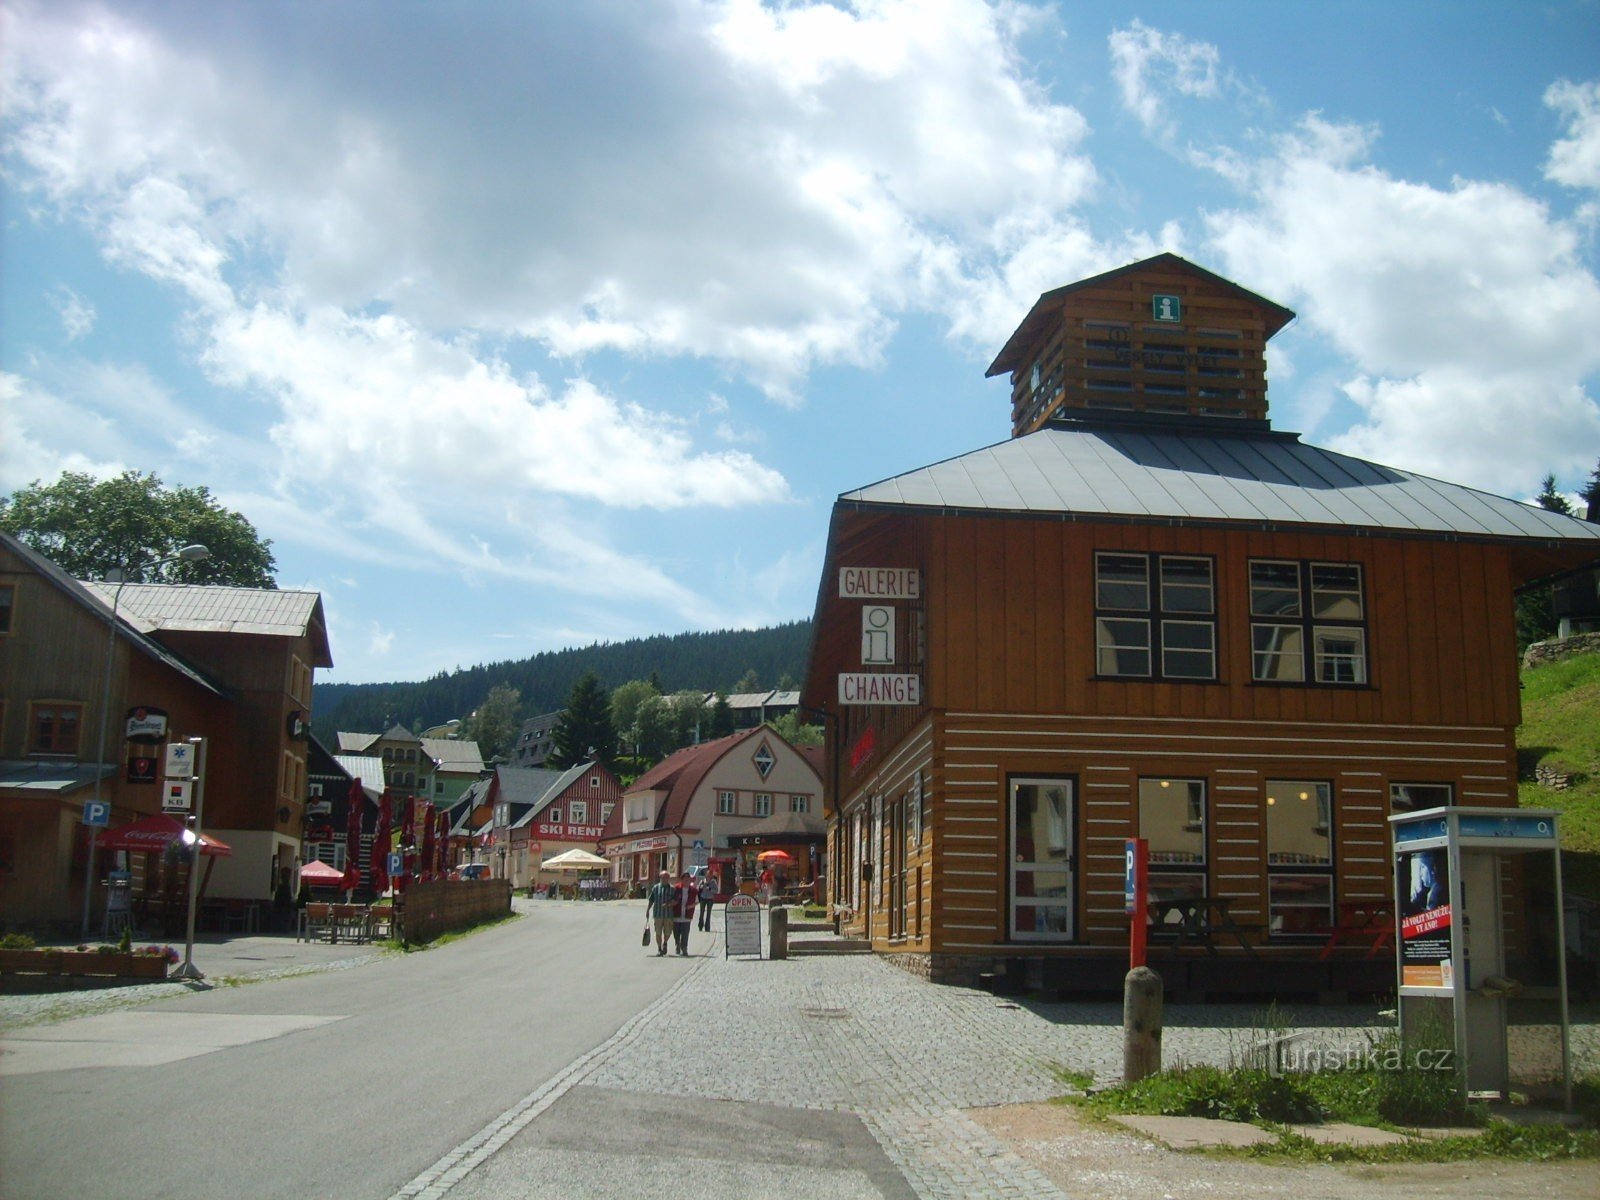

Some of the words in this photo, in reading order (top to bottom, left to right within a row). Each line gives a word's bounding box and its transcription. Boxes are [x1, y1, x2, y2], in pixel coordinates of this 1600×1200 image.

[845, 569, 916, 596] GALERIE
[844, 676, 916, 702] CHANGE
[90, 804, 105, 821] P
[539, 824, 563, 835] SKI
[567, 826, 604, 837] RENT
[392, 855, 400, 872] P
[1126, 850, 1134, 881] P
[731, 897, 752, 906] OPEN
[1409, 911, 1425, 925] VOLIT
[1424, 919, 1438, 931] ANO!
